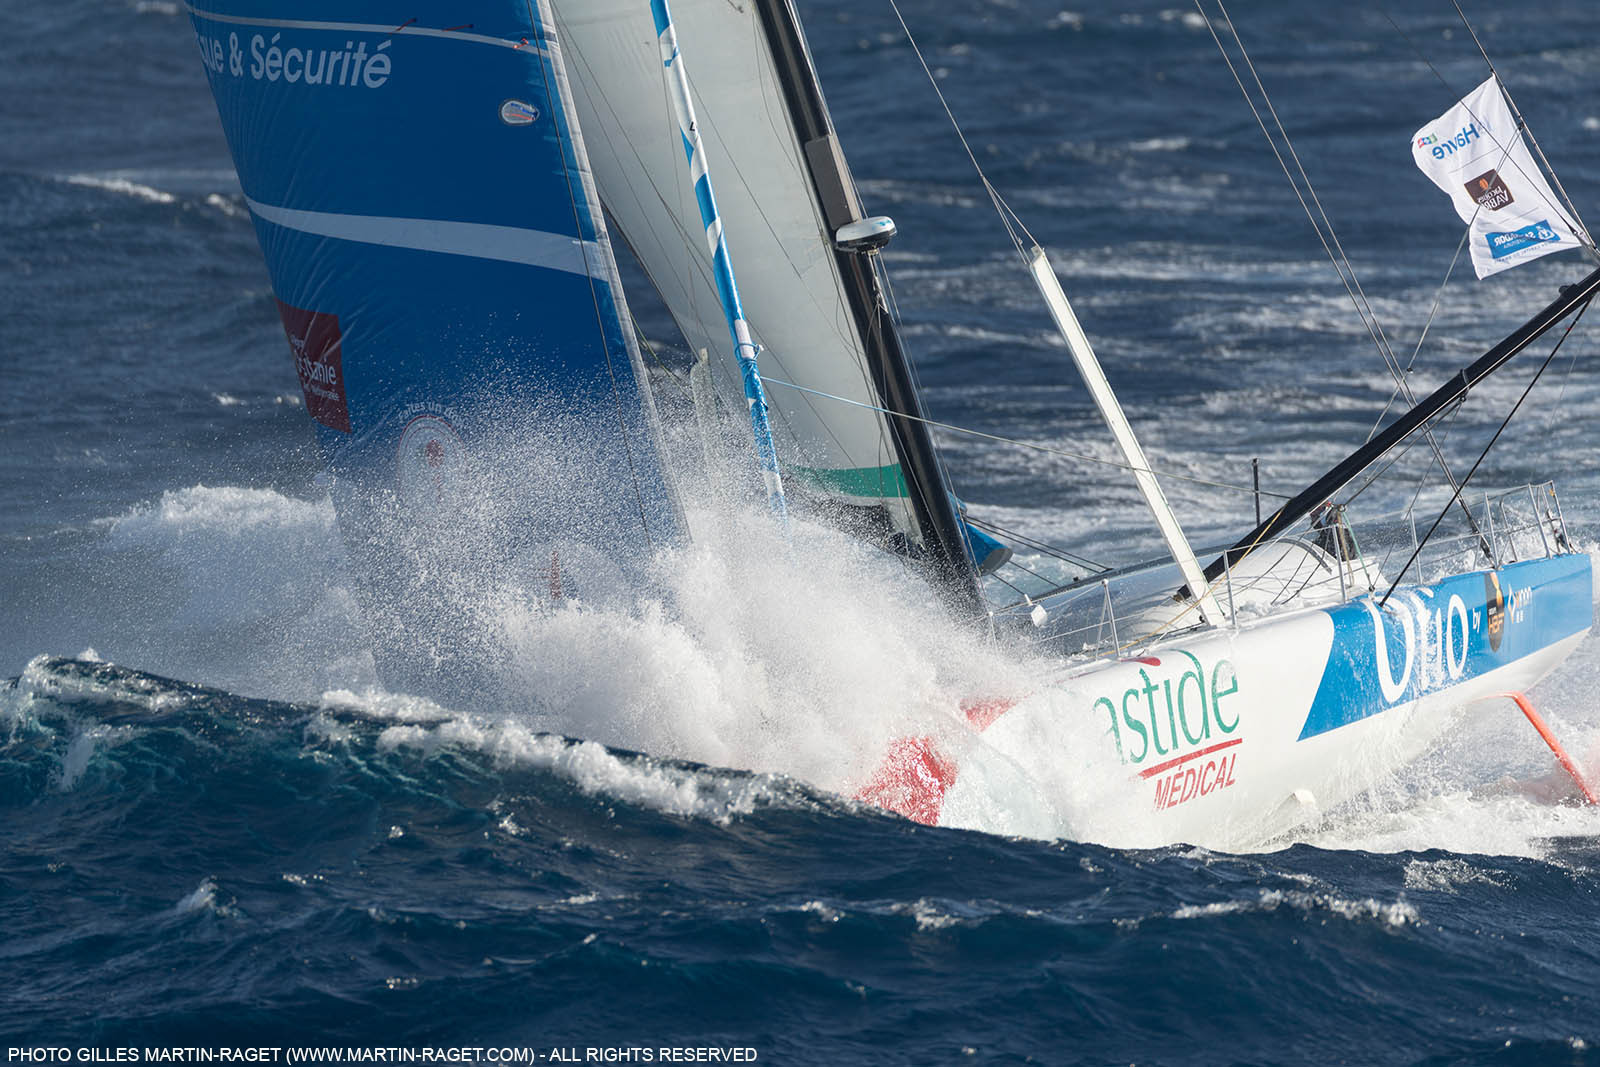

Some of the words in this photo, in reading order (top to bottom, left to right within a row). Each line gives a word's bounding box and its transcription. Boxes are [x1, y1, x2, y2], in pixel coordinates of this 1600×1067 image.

[229, 31, 244, 77] &
[250, 32, 392, 88] Sécurité
[1472, 608, 1481, 633] by
[1092, 649, 1240, 766] astide
[1153, 753, 1237, 812] MÉDICAL
